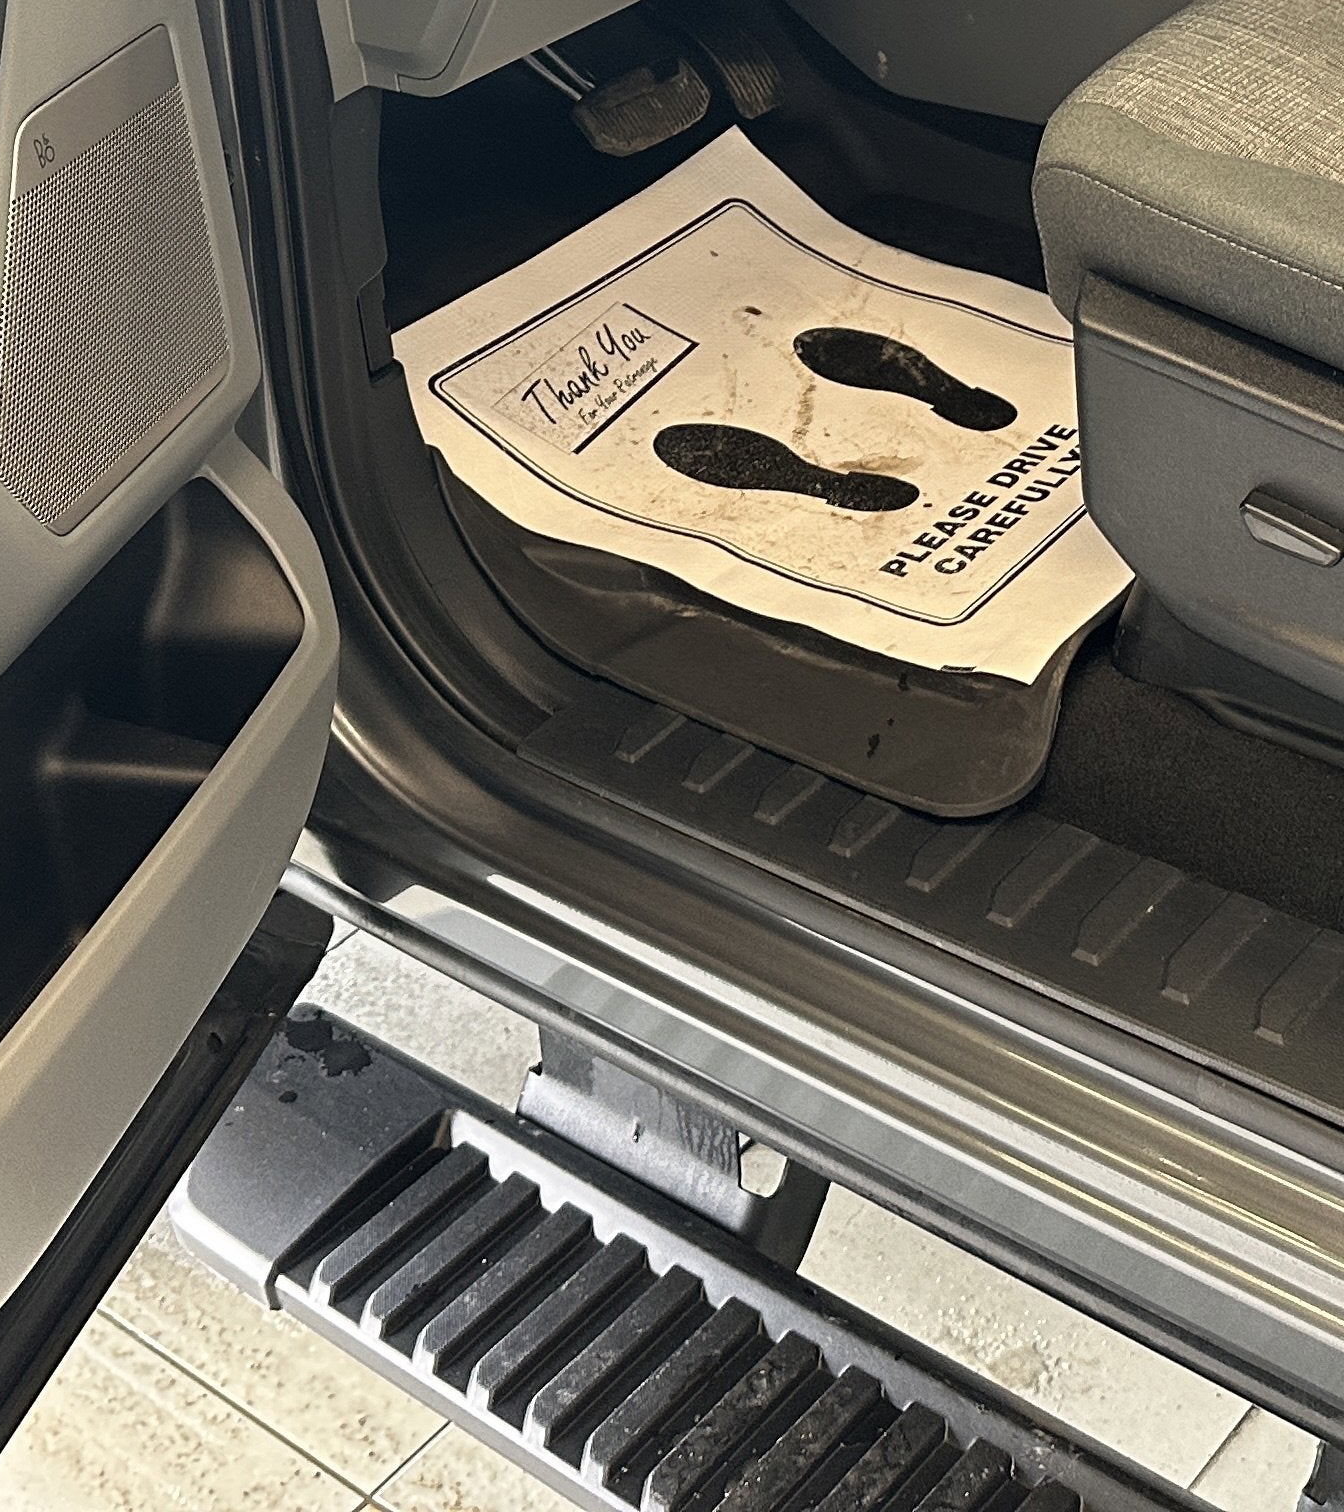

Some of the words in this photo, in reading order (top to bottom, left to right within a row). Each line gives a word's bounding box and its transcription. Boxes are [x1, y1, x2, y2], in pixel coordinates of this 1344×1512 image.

[521, 346, 609, 425] Thank
[596, 323, 651, 361] You
[879, 491, 999, 577] PLEASE
[986, 424, 1078, 489] DRIVE
[934, 444, 1081, 575] CAREFULLY
